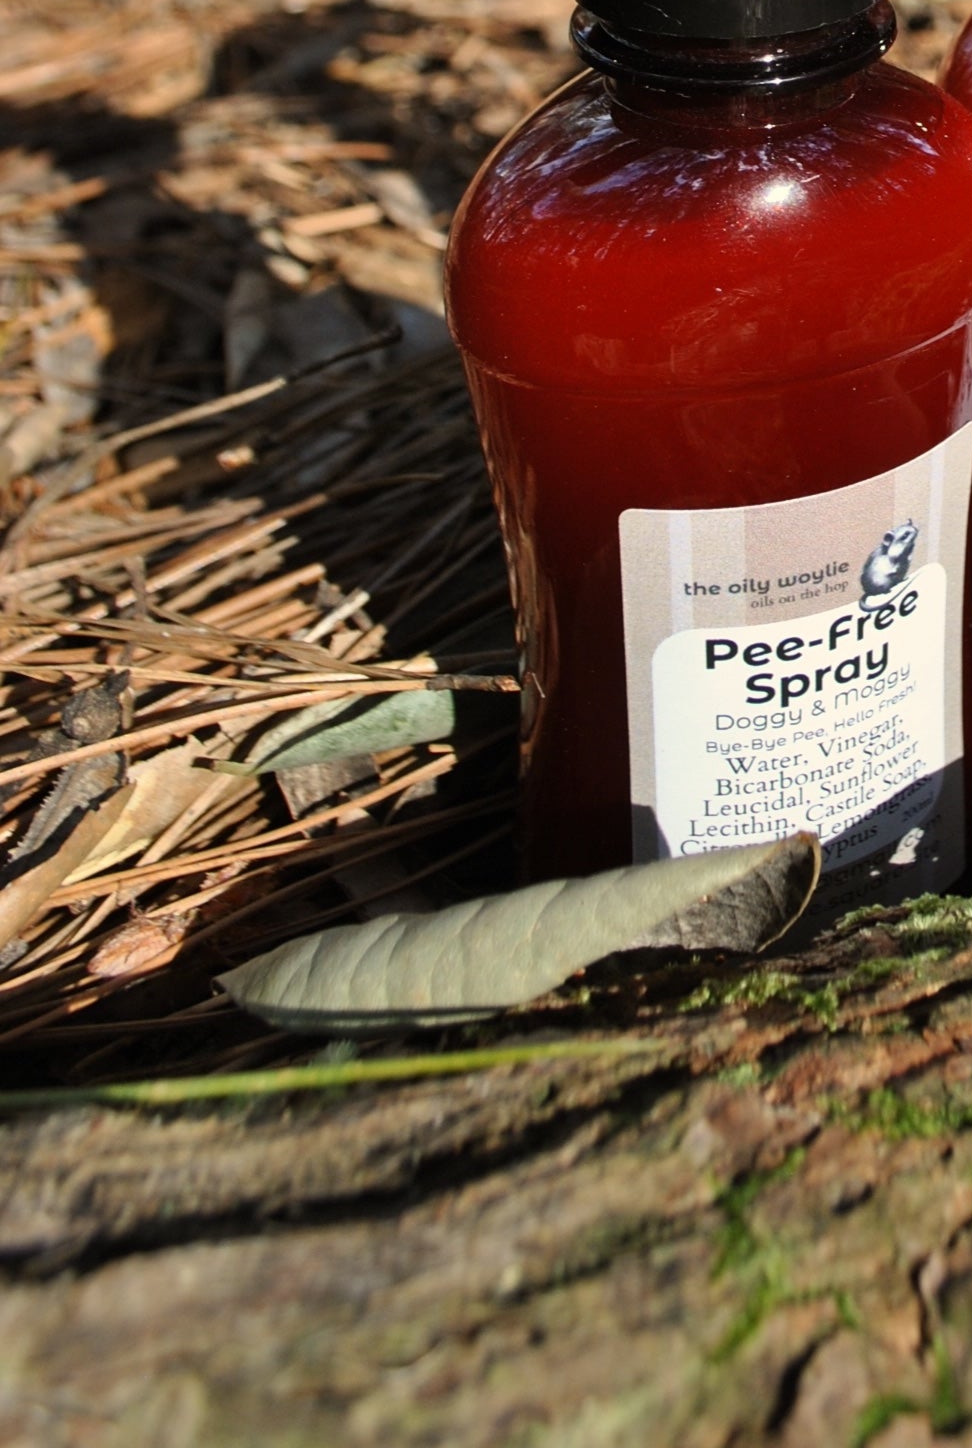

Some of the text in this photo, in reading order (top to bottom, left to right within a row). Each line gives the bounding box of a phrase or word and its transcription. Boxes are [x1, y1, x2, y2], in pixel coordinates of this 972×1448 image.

[683, 560, 850, 597] the oily woylie
[750, 594, 775, 610] oils
[800, 586, 820, 602] the
[824, 579, 849, 595] hop
[705, 590, 918, 669] Pee-Free
[746, 642, 890, 707] Spray
[706, 737, 787, 755] Bye-Bye
[834, 706, 874, 732] Hello
[715, 708, 803, 733] Doggy
[811, 700, 826, 716] &
[715, 757, 855, 797] Bicarbonate
[820, 741, 918, 800] Sunflower
[805, 783, 876, 823] Castile
[822, 824, 878, 864] yptus
